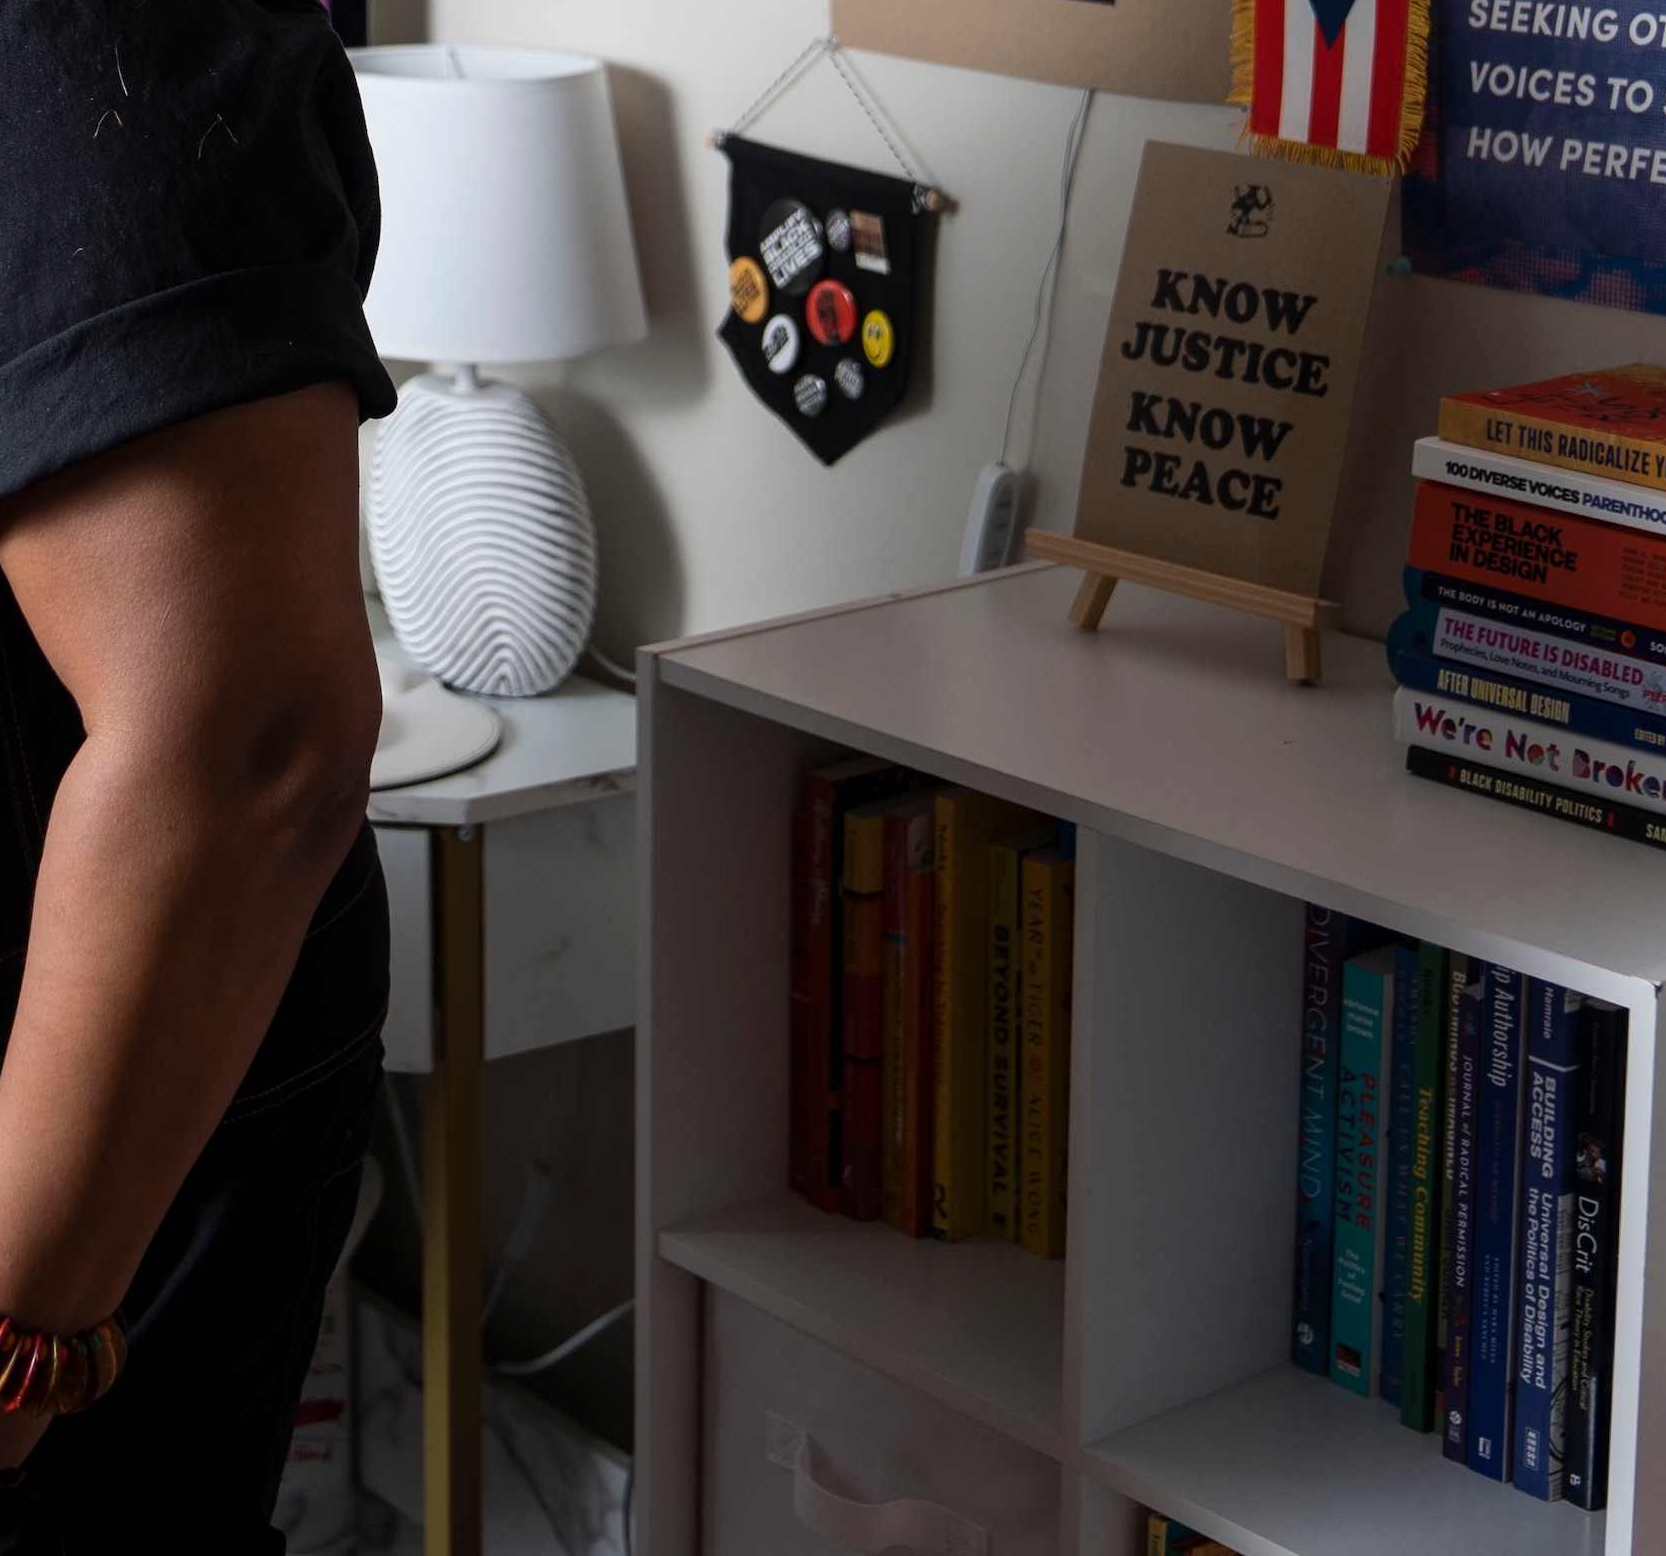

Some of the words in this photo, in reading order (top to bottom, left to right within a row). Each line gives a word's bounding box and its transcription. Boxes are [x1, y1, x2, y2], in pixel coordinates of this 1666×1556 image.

[1470, 61, 1596, 107] VOICES
[1607, 77, 1654, 114] TO
[1467, 126, 1552, 167] HOW
[1151, 268, 1318, 336] KNOW
[1120, 321, 1331, 398] JUSTICE
[1126, 390, 1294, 462] KNOW
[1486, 418, 1513, 444] LET
[1518, 424, 1553, 454] THIS
[1558, 433, 1650, 476] RADICALIZE
[1120, 446, 1283, 521] PEACE
[1445, 460, 1469, 479] 100
[1469, 468, 1527, 494] DIVERSE
[1529, 482, 1580, 504] VOICES
[1451, 502, 1490, 526] THE
[1494, 511, 1564, 548] BLACK
[1451, 523, 1578, 572] EXPERIENCE
[1449, 542, 1468, 564] IN
[1472, 550, 1548, 585] DESIGN
[1438, 586, 1455, 598] THE
[1459, 591, 1484, 606] BODY
[1488, 598, 1497, 610] IS
[1499, 602, 1519, 614] NOT
[1521, 608, 1535, 619] AN
[1538, 613, 1586, 633] APOLOGY
[1440, 637, 1489, 661] Prophecies,
[1489, 652, 1511, 667] Love
[1511, 657, 1539, 674] Notes,
[1540, 665, 1559, 679] and
[1558, 670, 1603, 693] Mourning
[1603, 681, 1631, 701] Songs
[1445, 617, 1474, 639] THE
[1476, 626, 1540, 660] FUTURE
[1543, 647, 1559, 663] IS
[1561, 652, 1644, 686] DISABLED
[1437, 669, 1471, 696] AFTER
[1470, 678, 1527, 712] UNIVERSAL
[1530, 693, 1571, 724] DESIGN
[1414, 702, 1493, 751] We're
[1505, 729, 1561, 772] Not
[1634, 728, 1656, 743] EDITED
[1459, 769, 1492, 791] BLACK
[1494, 778, 1552, 809] DISABILITY
[1555, 796, 1603, 824] POLITICS
[1028, 888, 1044, 943] YEAR
[993, 924, 1011, 1044] BEYOND
[1303, 906, 1331, 1100] DIVERGENT
[1487, 987, 1515, 1088] Authorship
[1461, 1054, 1474, 1118] JOURNAL
[1530, 1070, 1544, 1159] ACCESS
[992, 1055, 1010, 1196] SURVIVAL
[1027, 1092, 1042, 1158] ALICE
[1300, 1106, 1324, 1198] MIND
[1336, 1065, 1356, 1222] ACTIVISM
[1355, 1072, 1377, 1232] PLEASURE
[1413, 1087, 1434, 1180] Teaching
[1542, 1076, 1557, 1180] BUILDING
[1459, 1136, 1471, 1197] RADICAL
[1027, 1171, 1042, 1236] WONG
[1527, 1187, 1540, 1215] the
[1408, 1185, 1430, 1305] Community
[1456, 1202, 1469, 1288] PERMISSION
[1526, 1217, 1539, 1280] Politics
[1538, 1193, 1553, 1281] Universal
[1575, 1195, 1599, 1274] DisCrit
[1524, 1283, 1537, 1303] of
[1535, 1284, 1550, 1348] Design
[1520, 1304, 1536, 1384] Disability
[1534, 1352, 1546, 1390] and
